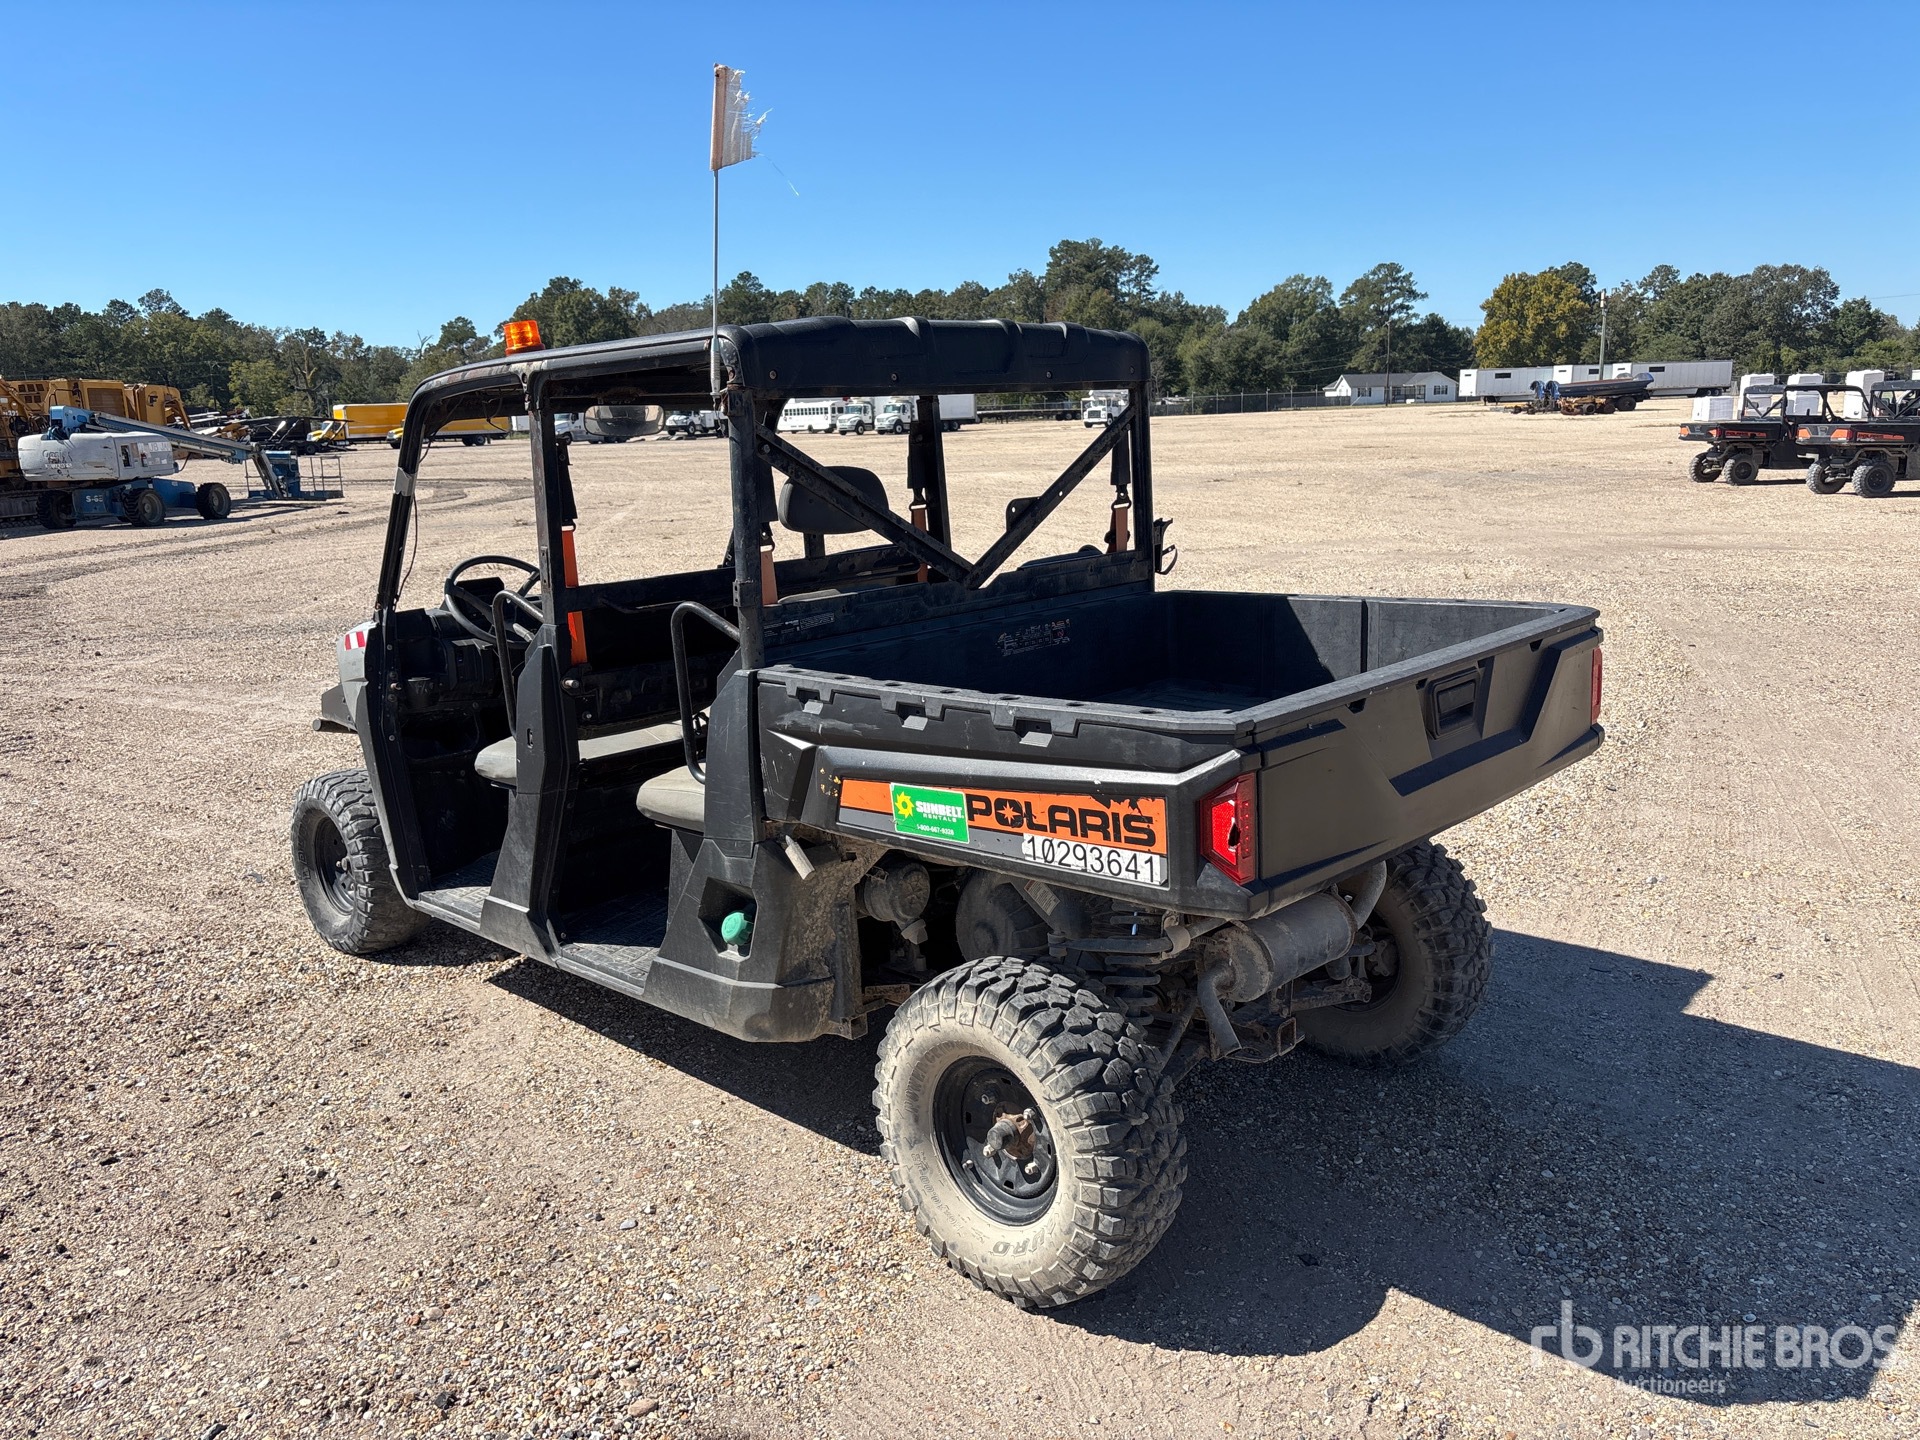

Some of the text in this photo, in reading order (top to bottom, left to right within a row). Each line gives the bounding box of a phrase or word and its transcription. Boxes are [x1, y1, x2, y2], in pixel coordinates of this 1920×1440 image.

[915, 800, 963, 819] SUNBELT
[922, 812, 957, 823] RENTALS
[966, 793, 1157, 847] POLARIS
[1026, 835, 1155, 883] 10293641
